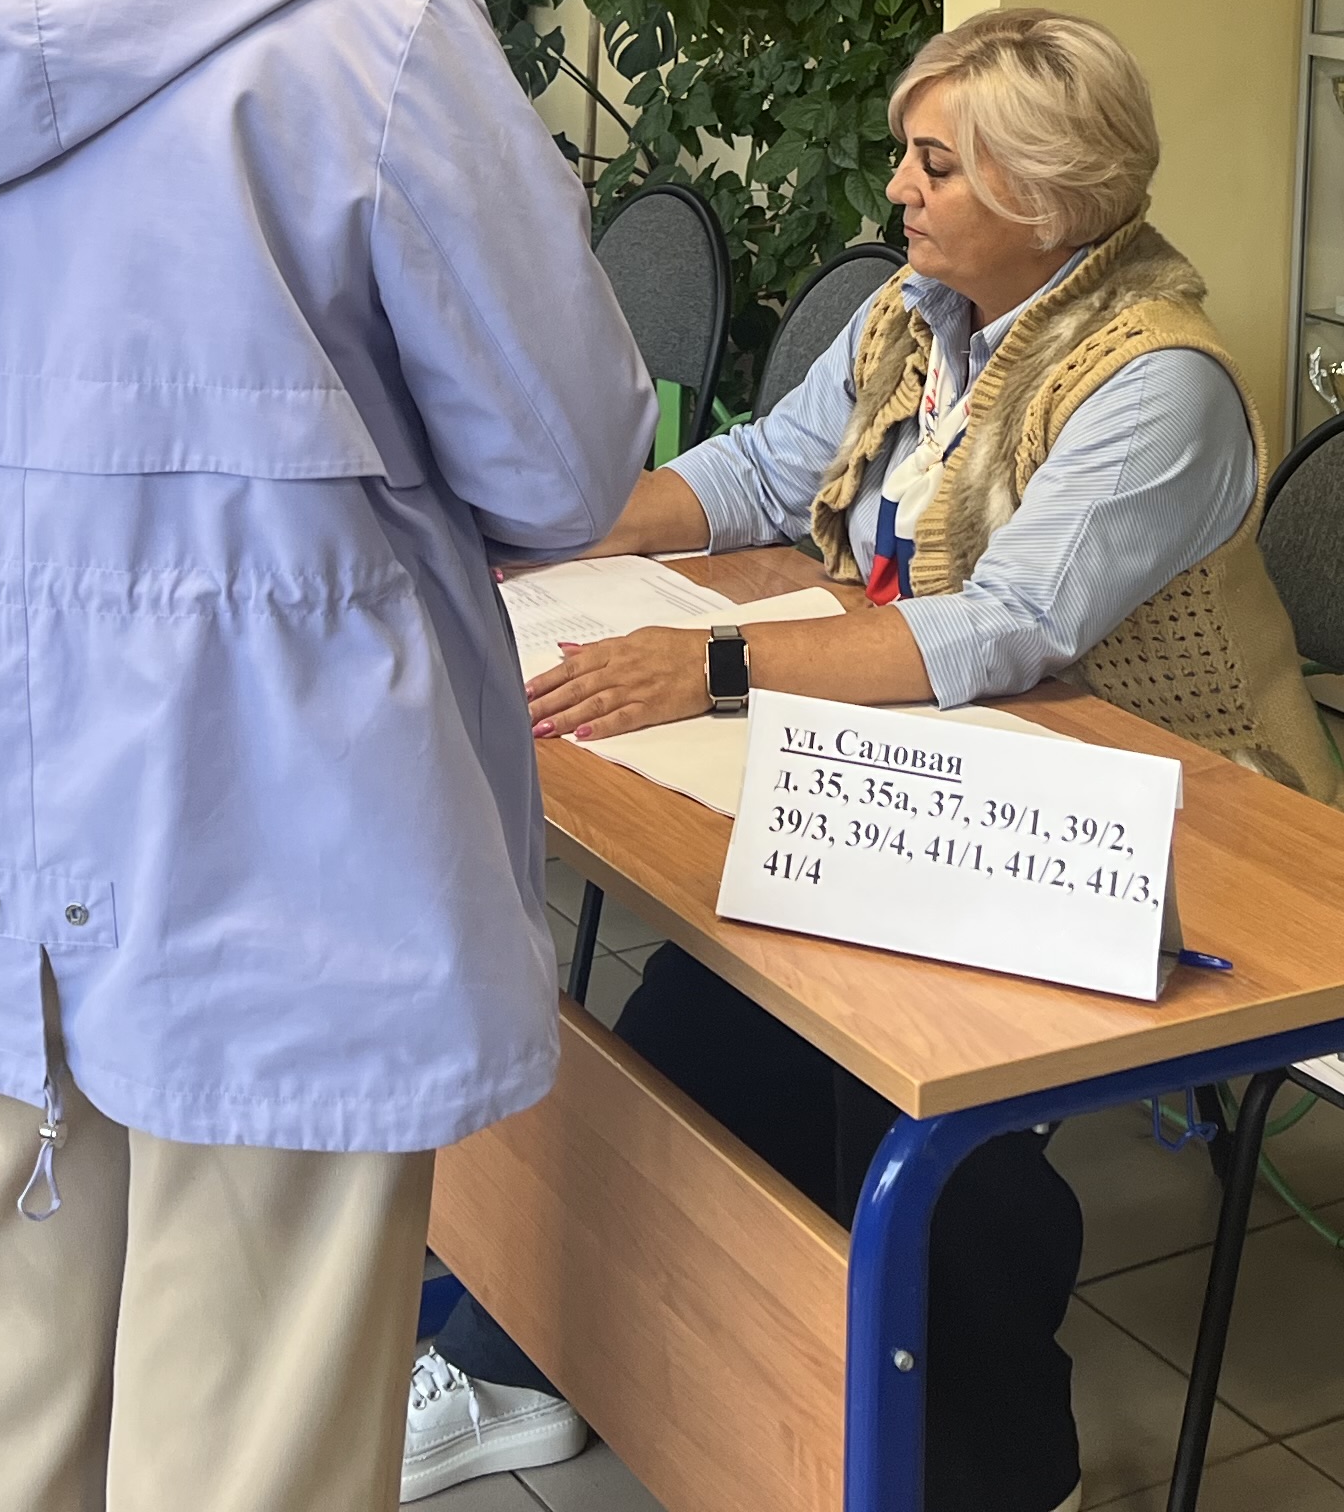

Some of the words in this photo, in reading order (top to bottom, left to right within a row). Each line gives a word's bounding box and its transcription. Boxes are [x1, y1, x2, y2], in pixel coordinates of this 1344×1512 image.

[782, 726, 824, 753] ул.
[835, 729, 963, 778] Садовая
[773, 769, 798, 793] д.
[808, 769, 850, 805] 35,
[859, 778, 919, 817] 35а,
[927, 791, 971, 828] 37,
[980, 799, 1052, 843] 39/1,
[1060, 814, 1135, 857] 39/2,
[763, 850, 822, 886] 41/4
[768, 806, 835, 847] 39/3,
[844, 820, 914, 864] 39/4,
[924, 835, 994, 876] 41/1,
[1004, 851, 1075, 894] 41/2,
[1086, 866, 1160, 910] 41/3,
